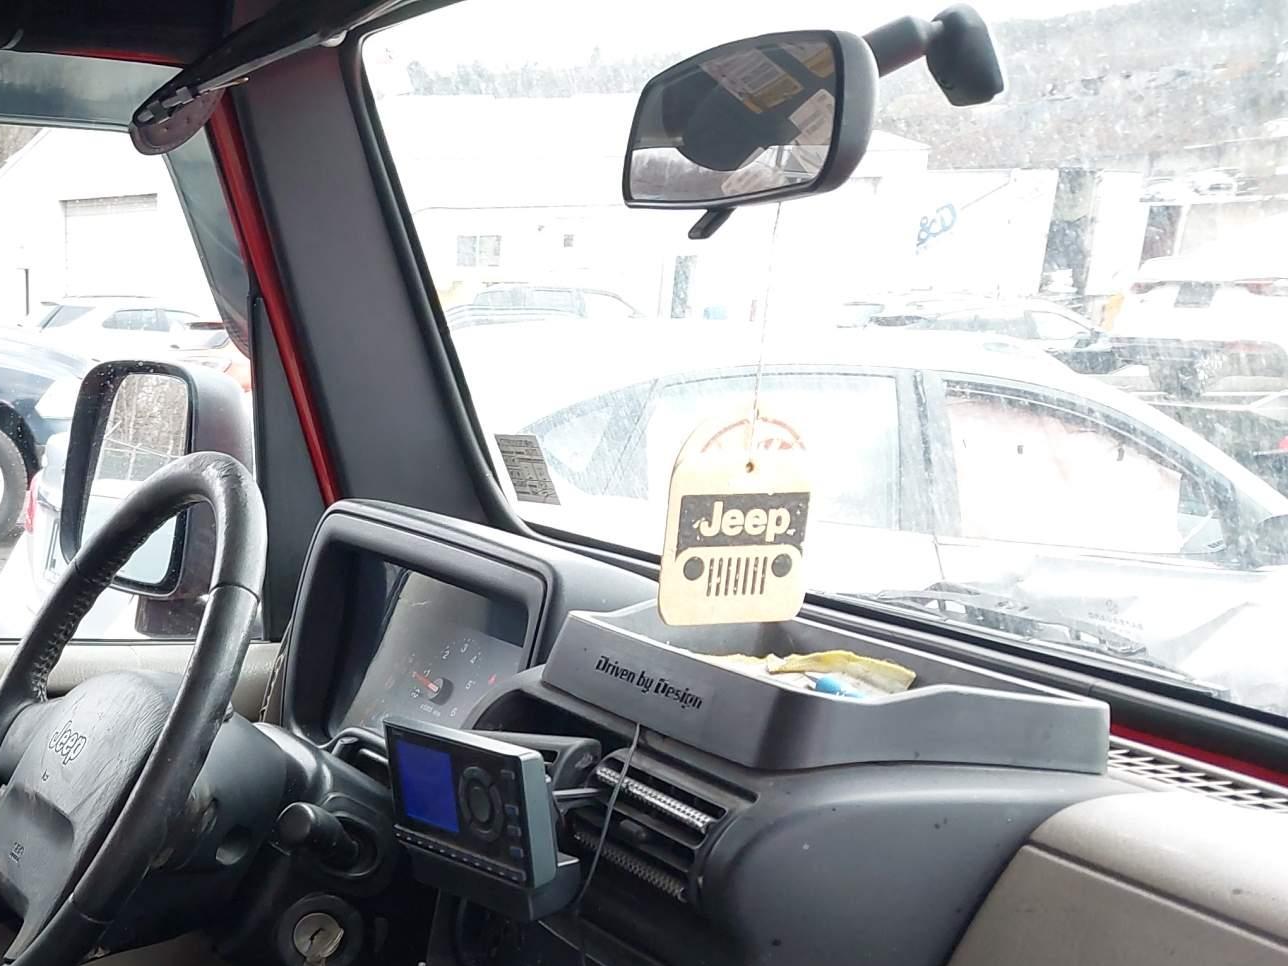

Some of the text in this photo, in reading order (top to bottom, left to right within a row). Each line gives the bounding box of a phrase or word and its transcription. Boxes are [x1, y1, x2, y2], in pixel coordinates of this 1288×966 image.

[698, 500, 791, 543] Jeep
[595, 655, 703, 709] Driven by Design
[48, 720, 88, 766] Jeep
